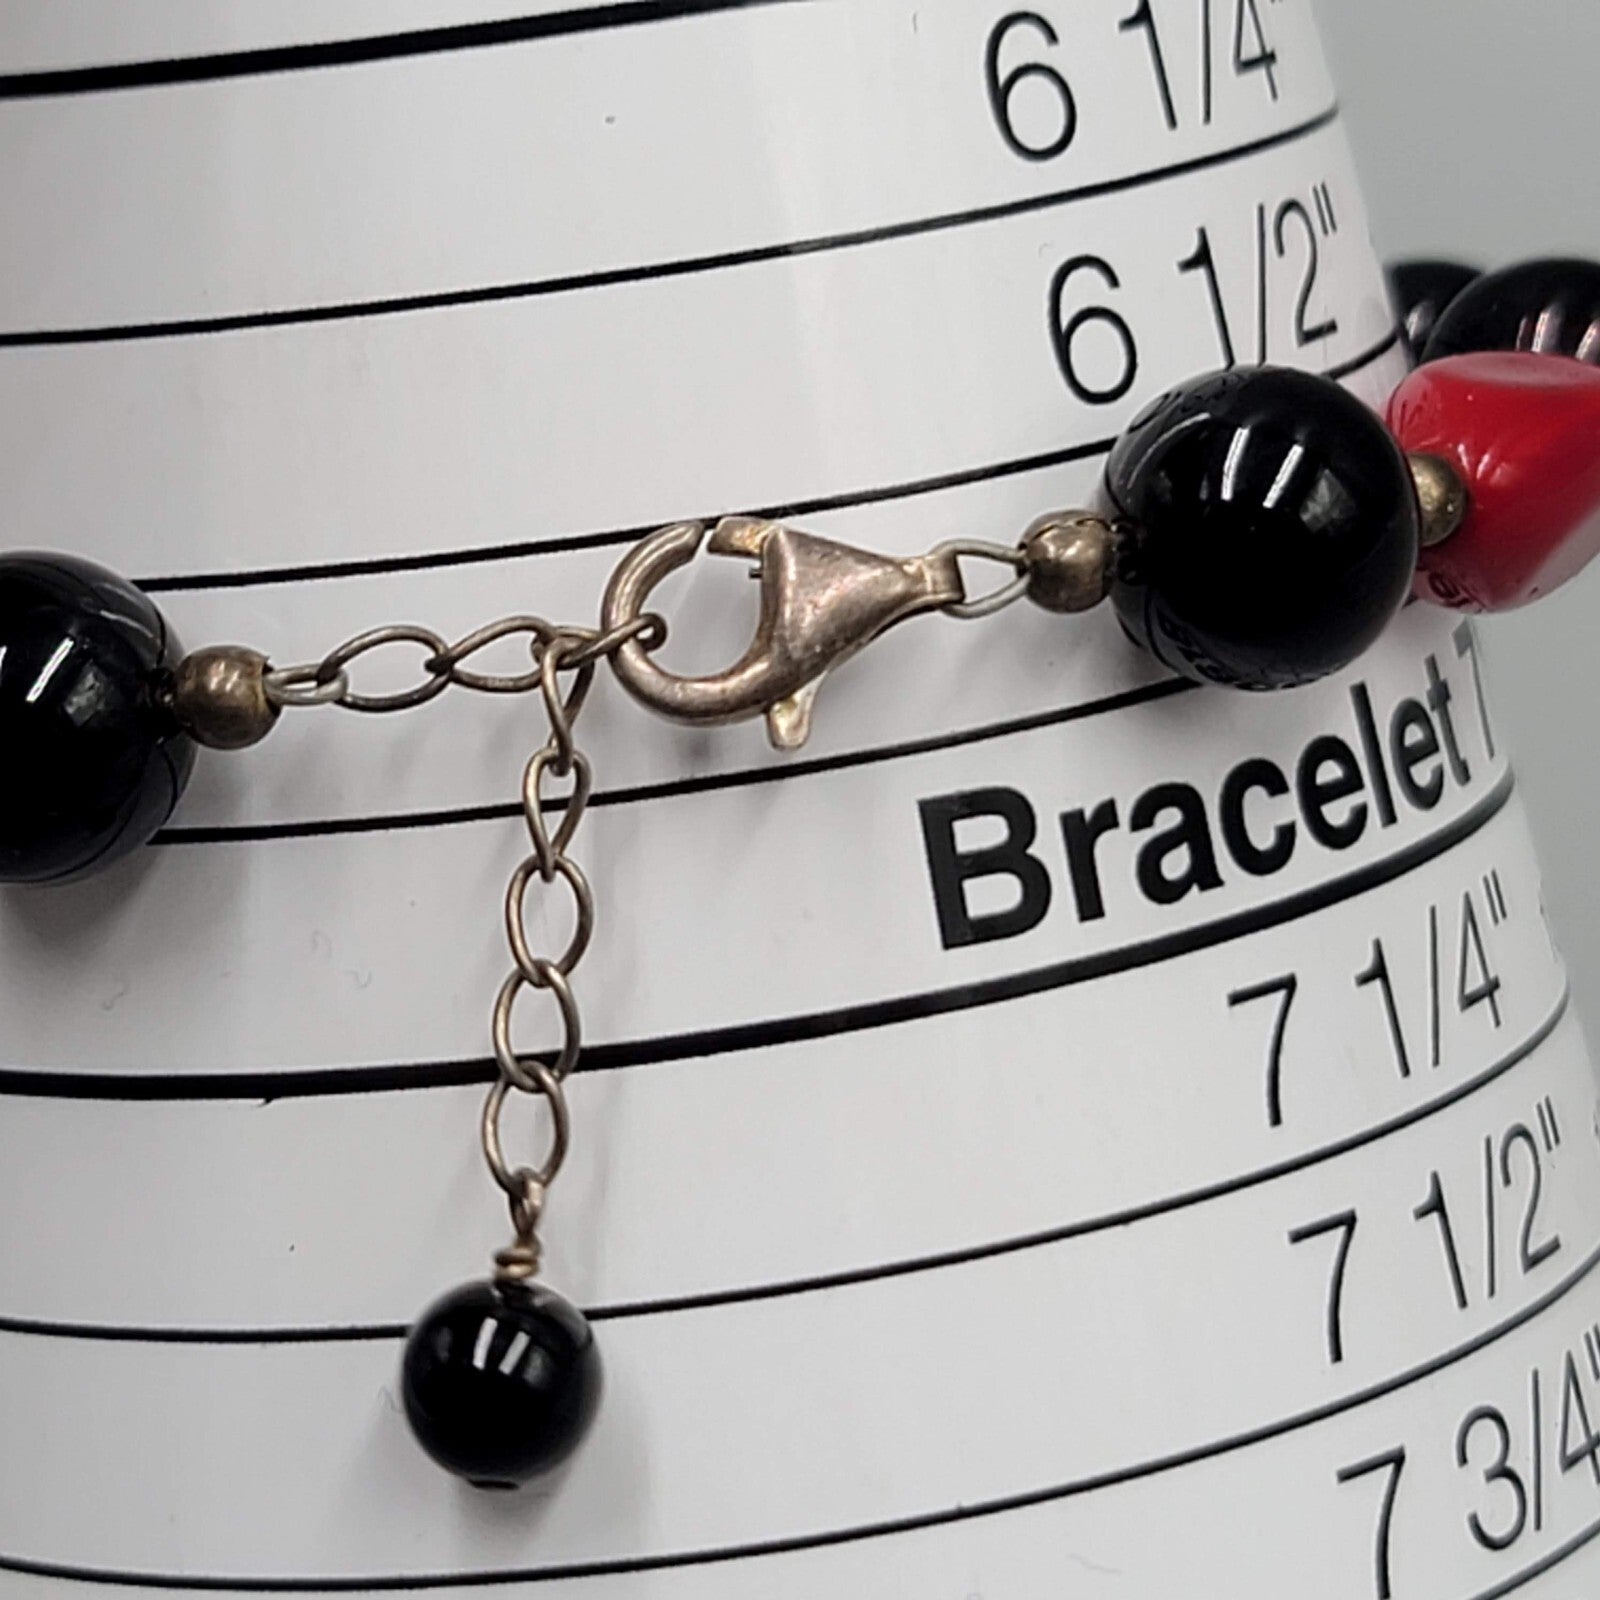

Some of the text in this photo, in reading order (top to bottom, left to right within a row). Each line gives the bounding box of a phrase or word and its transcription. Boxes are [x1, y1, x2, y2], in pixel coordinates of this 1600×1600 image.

[985, 10, 1077, 162] 6
[1049, 182, 1338, 406] 6 1/2"
[917, 653, 1472, 950] Bracelet
[1226, 868, 1507, 1128] 7 1/4"
[1288, 1095, 1561, 1363] 7 1/2"
[1336, 1444, 1406, 1599] 7
